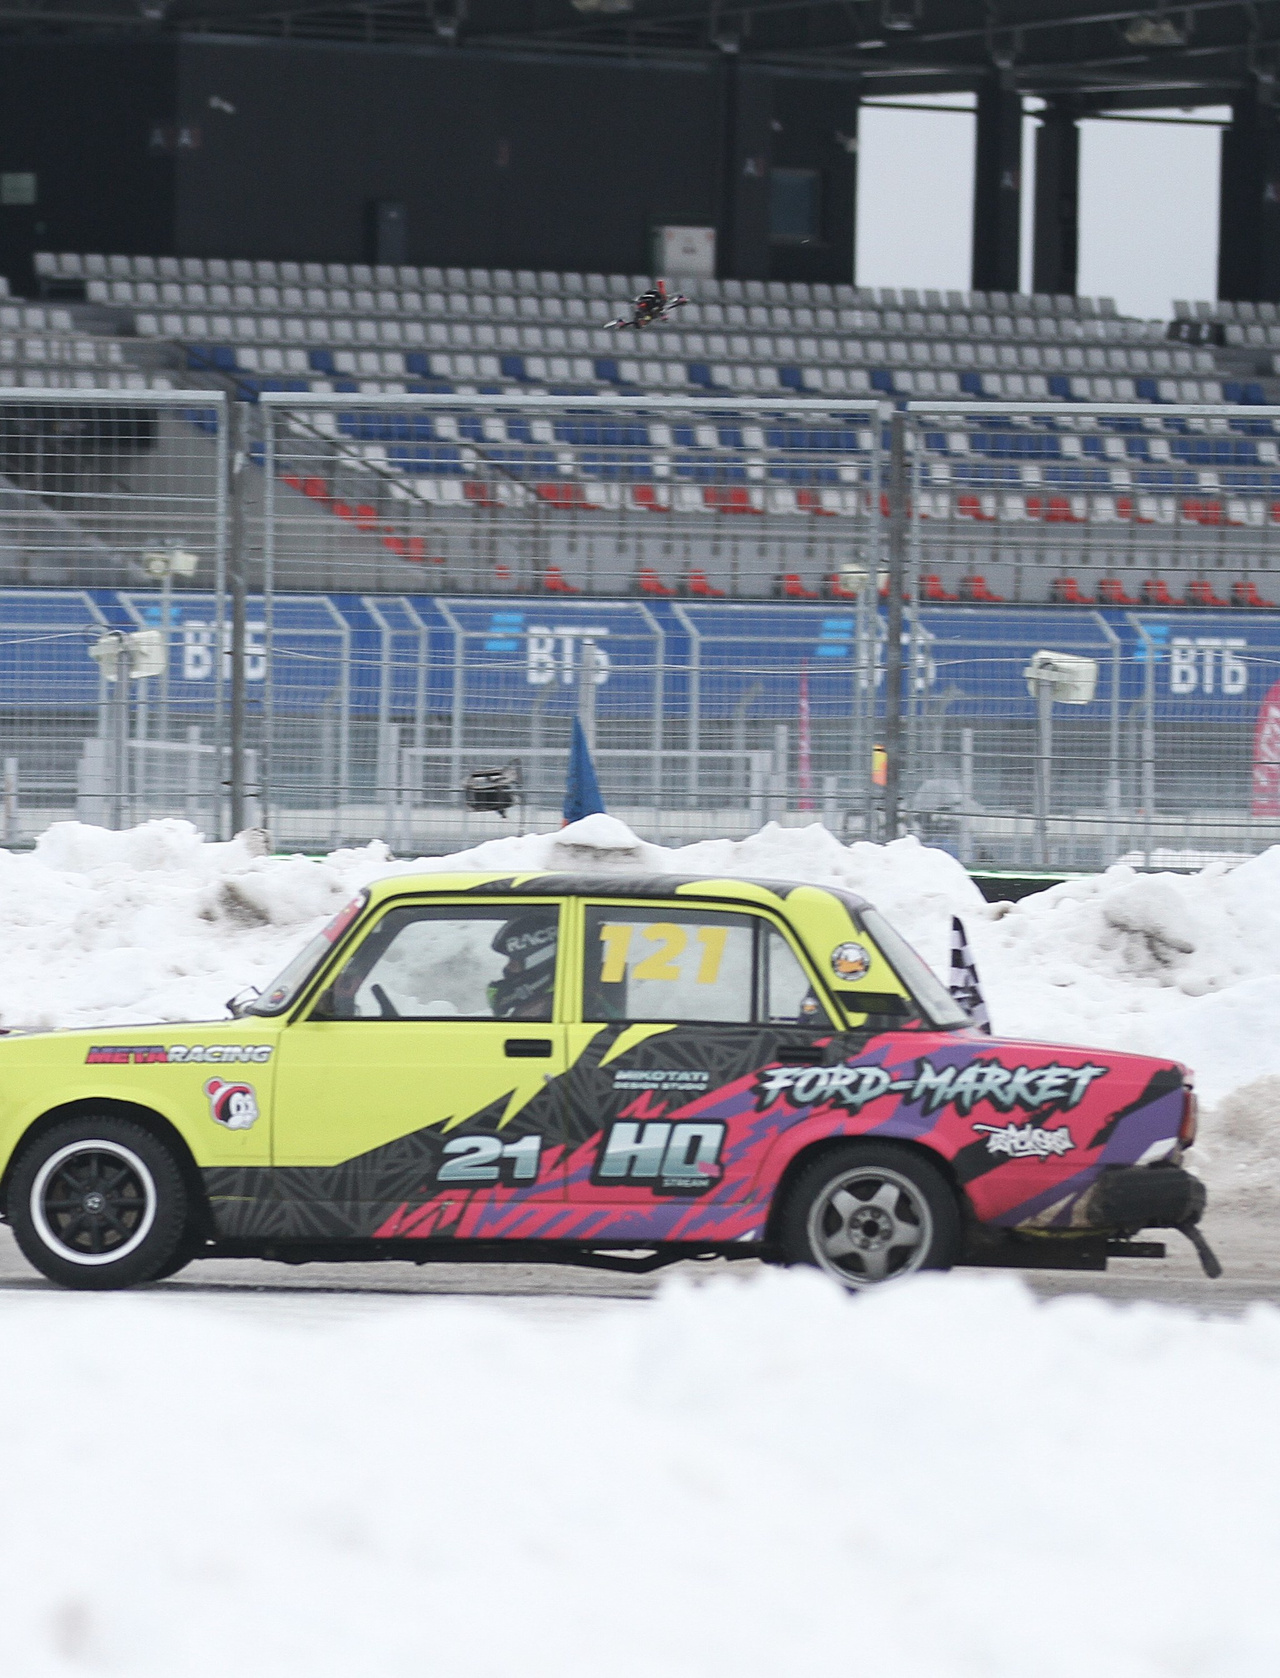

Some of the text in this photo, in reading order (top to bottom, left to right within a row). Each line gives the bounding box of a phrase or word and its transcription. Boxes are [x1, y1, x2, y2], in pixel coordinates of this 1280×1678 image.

[527, 627, 609, 684] ВТБ
[1171, 638, 1247, 694] ВТБ
[599, 922, 729, 984] 121
[762, 1062, 1109, 1109] FORD-MARKET
[437, 1135, 541, 1181] 21
